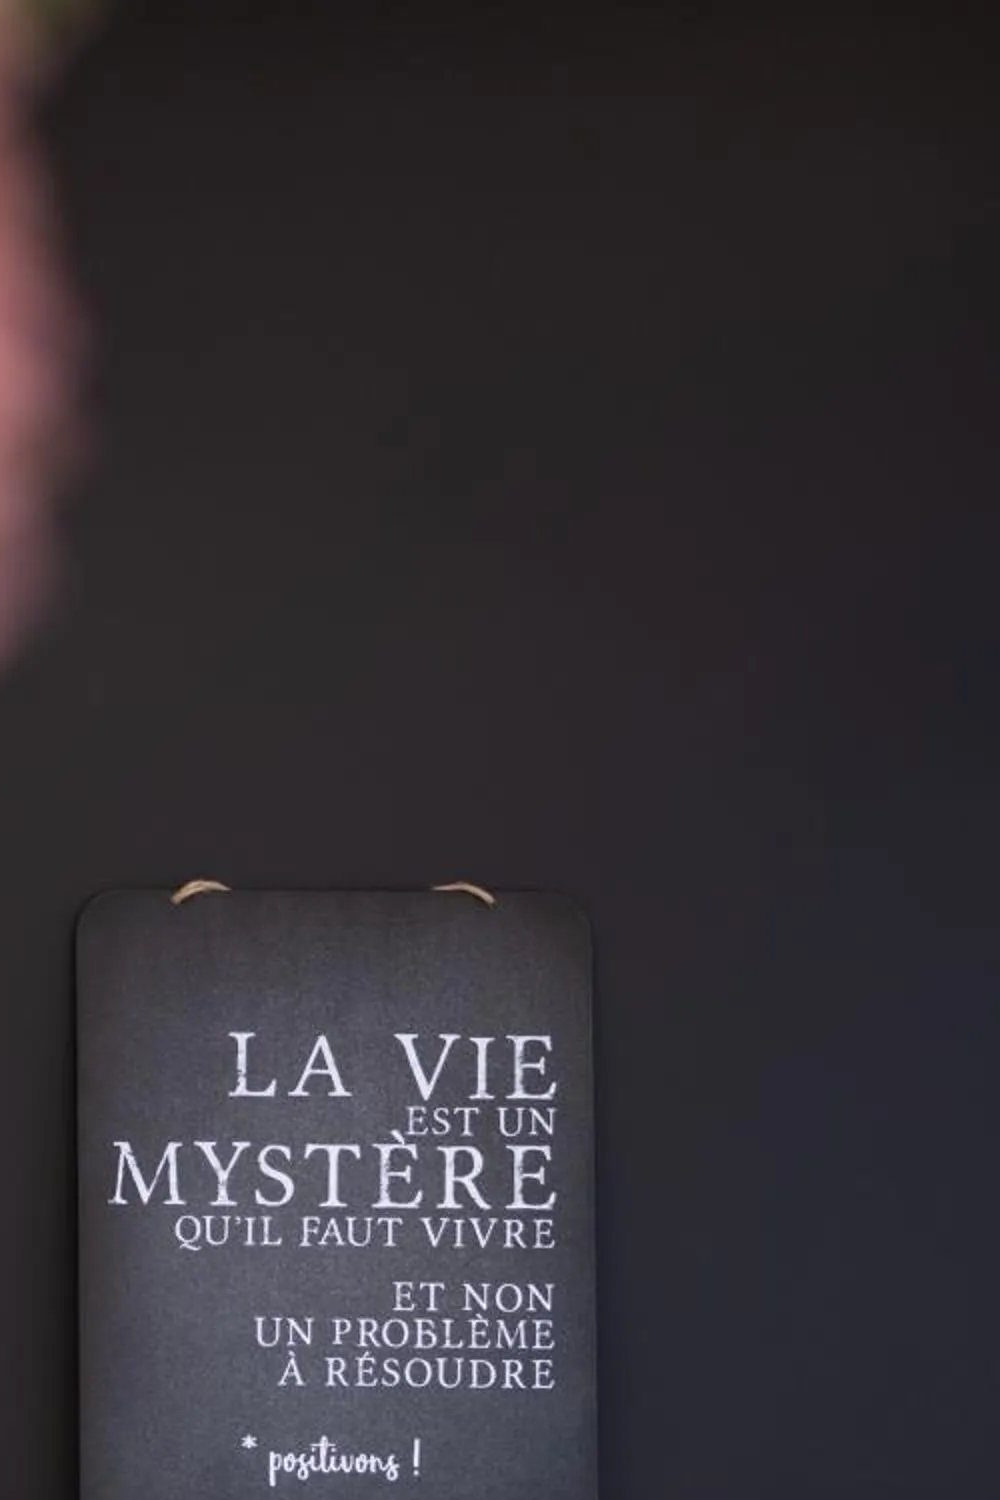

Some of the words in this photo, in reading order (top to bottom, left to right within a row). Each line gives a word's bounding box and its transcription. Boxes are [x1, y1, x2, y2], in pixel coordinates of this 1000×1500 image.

[228, 1031, 353, 1097] LA
[393, 1033, 558, 1101] VIE
[406, 1105, 480, 1137] EST
[498, 1107, 556, 1137] UN
[107, 1129, 558, 1211] MYSTÈRE
[174, 1215, 283, 1251] QU'IL
[299, 1216, 403, 1247] FAUT
[420, 1217, 556, 1249] VIVRE
[392, 1281, 446, 1312] ET
[462, 1283, 555, 1312] NON
[254, 1316, 315, 1347] UN
[331, 1314, 556, 1350] PROBLÈME
[276, 1350, 306, 1386] À
[324, 1352, 556, 1389] RÉSOUDRE
[268, 1434, 401, 1487] positivons
